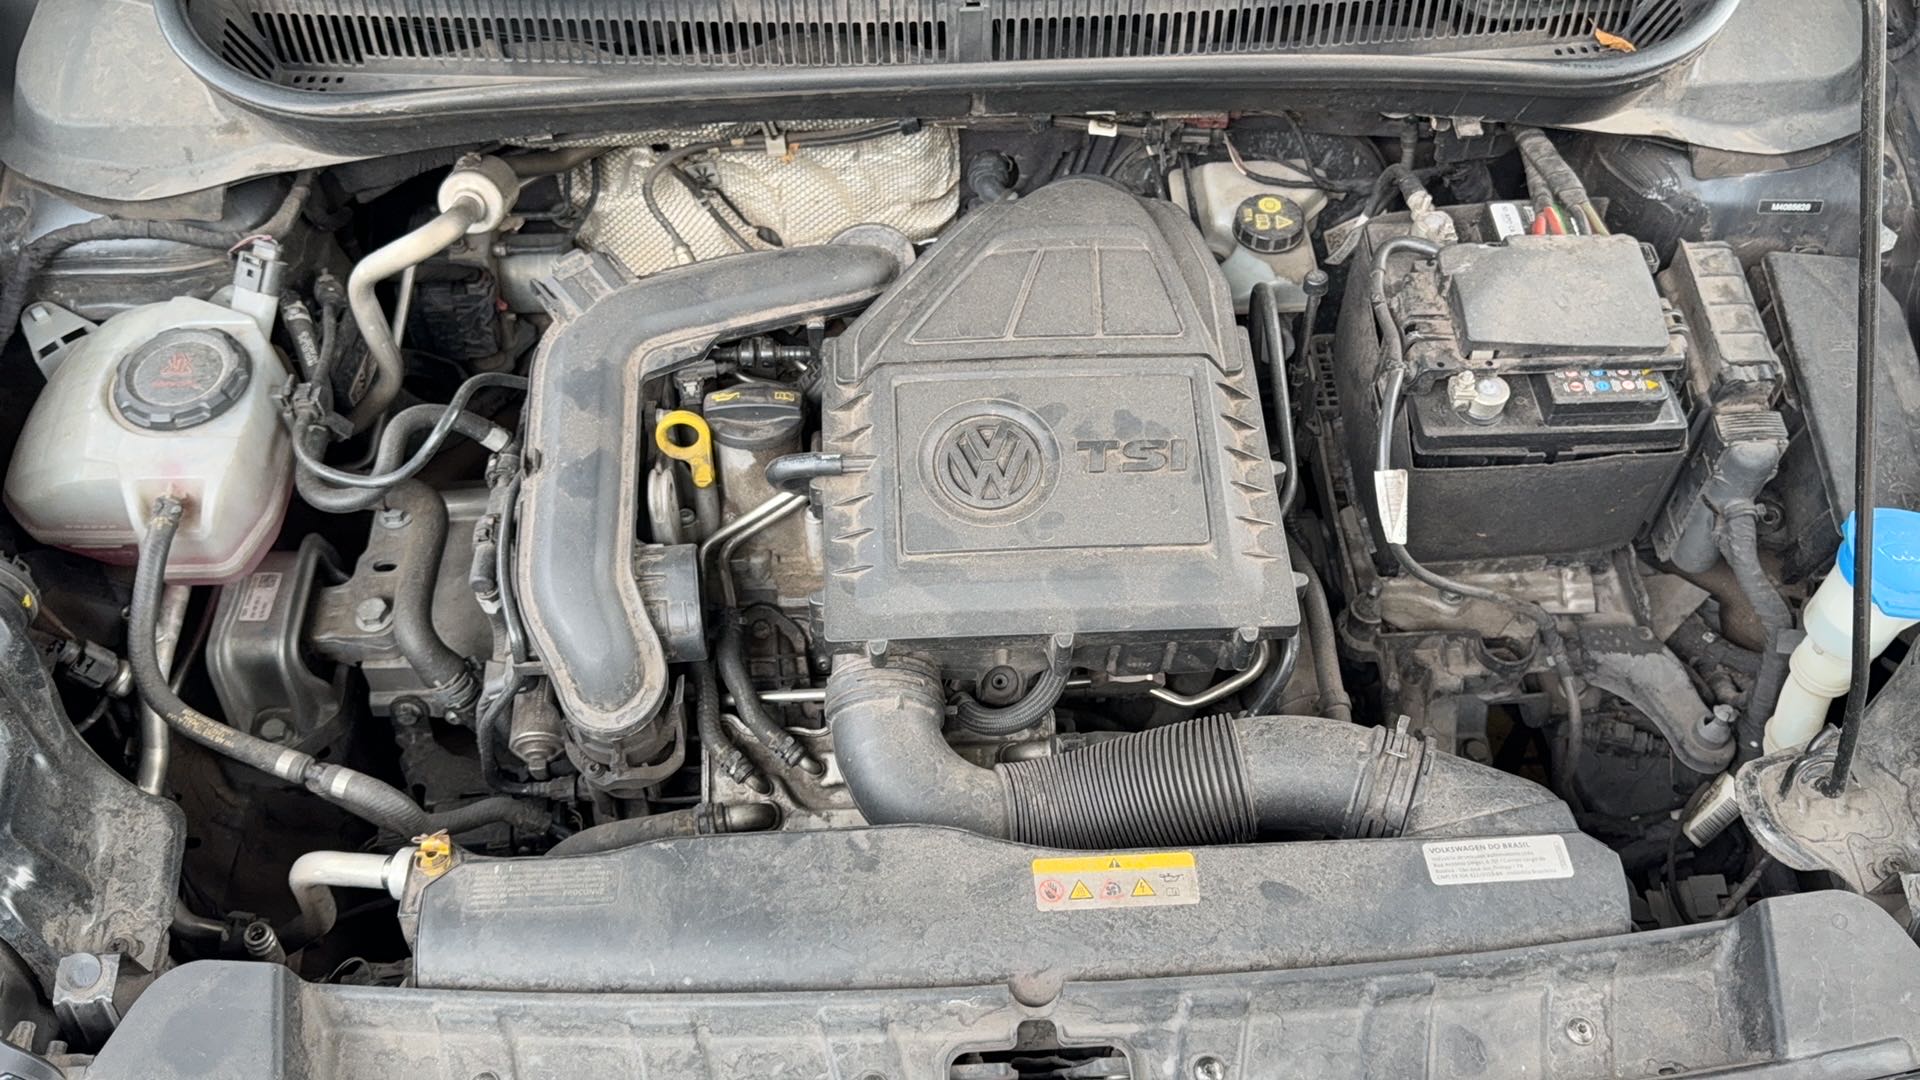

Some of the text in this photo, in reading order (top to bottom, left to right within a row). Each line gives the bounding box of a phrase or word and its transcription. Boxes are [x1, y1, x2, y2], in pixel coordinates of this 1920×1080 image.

[1076, 439, 1188, 474] TSI
[1429, 845, 1486, 853] VOLKSWAGEN
[1502, 841, 1531, 849] BRASIL
